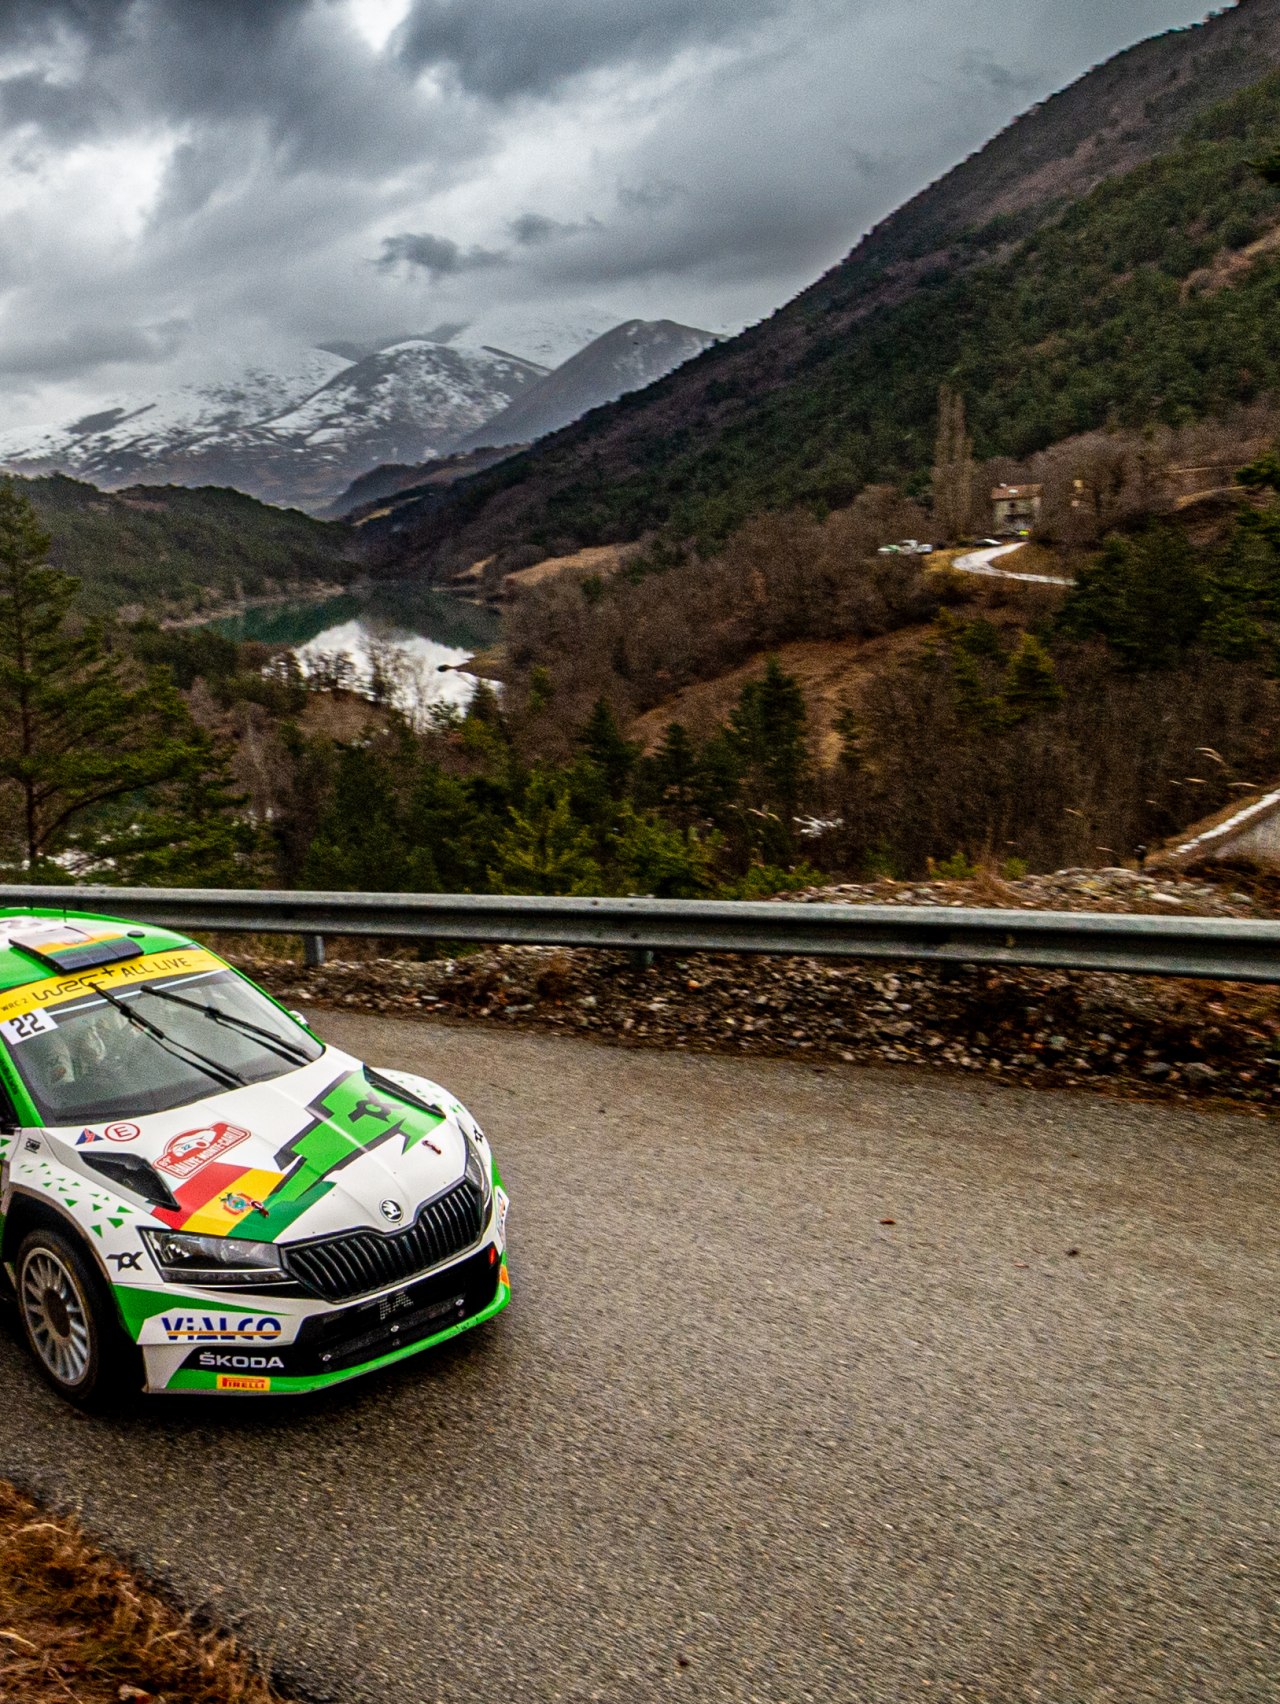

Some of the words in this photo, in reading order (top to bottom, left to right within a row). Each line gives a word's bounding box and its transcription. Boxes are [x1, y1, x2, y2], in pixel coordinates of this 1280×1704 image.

[121, 964, 152, 978] ALL
[158, 957, 192, 972] LIVE
[0, 1001, 21, 1012] WRC
[9, 1012, 46, 1038] 22
[199, 1352, 285, 1369] ŠKODA
[222, 1377, 266, 1389] PIRELLI
